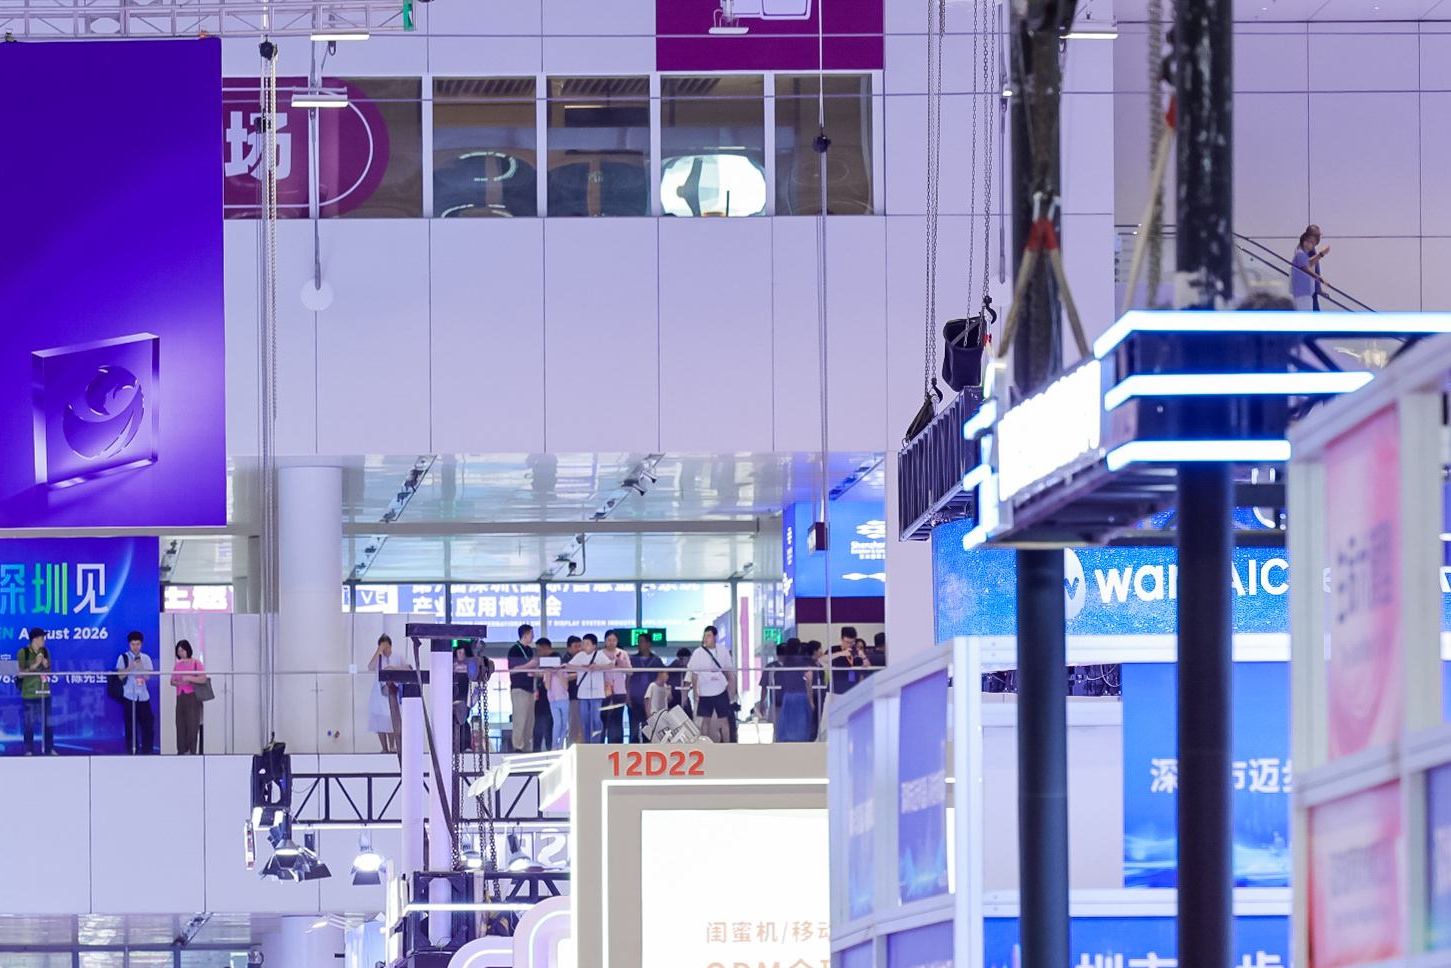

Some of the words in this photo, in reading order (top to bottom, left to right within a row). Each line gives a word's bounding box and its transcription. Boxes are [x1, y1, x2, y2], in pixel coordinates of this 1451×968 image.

[225, 111, 292, 181] 场
[73, 626, 109, 641] 2026
[608, 751, 705, 778] 12D22
